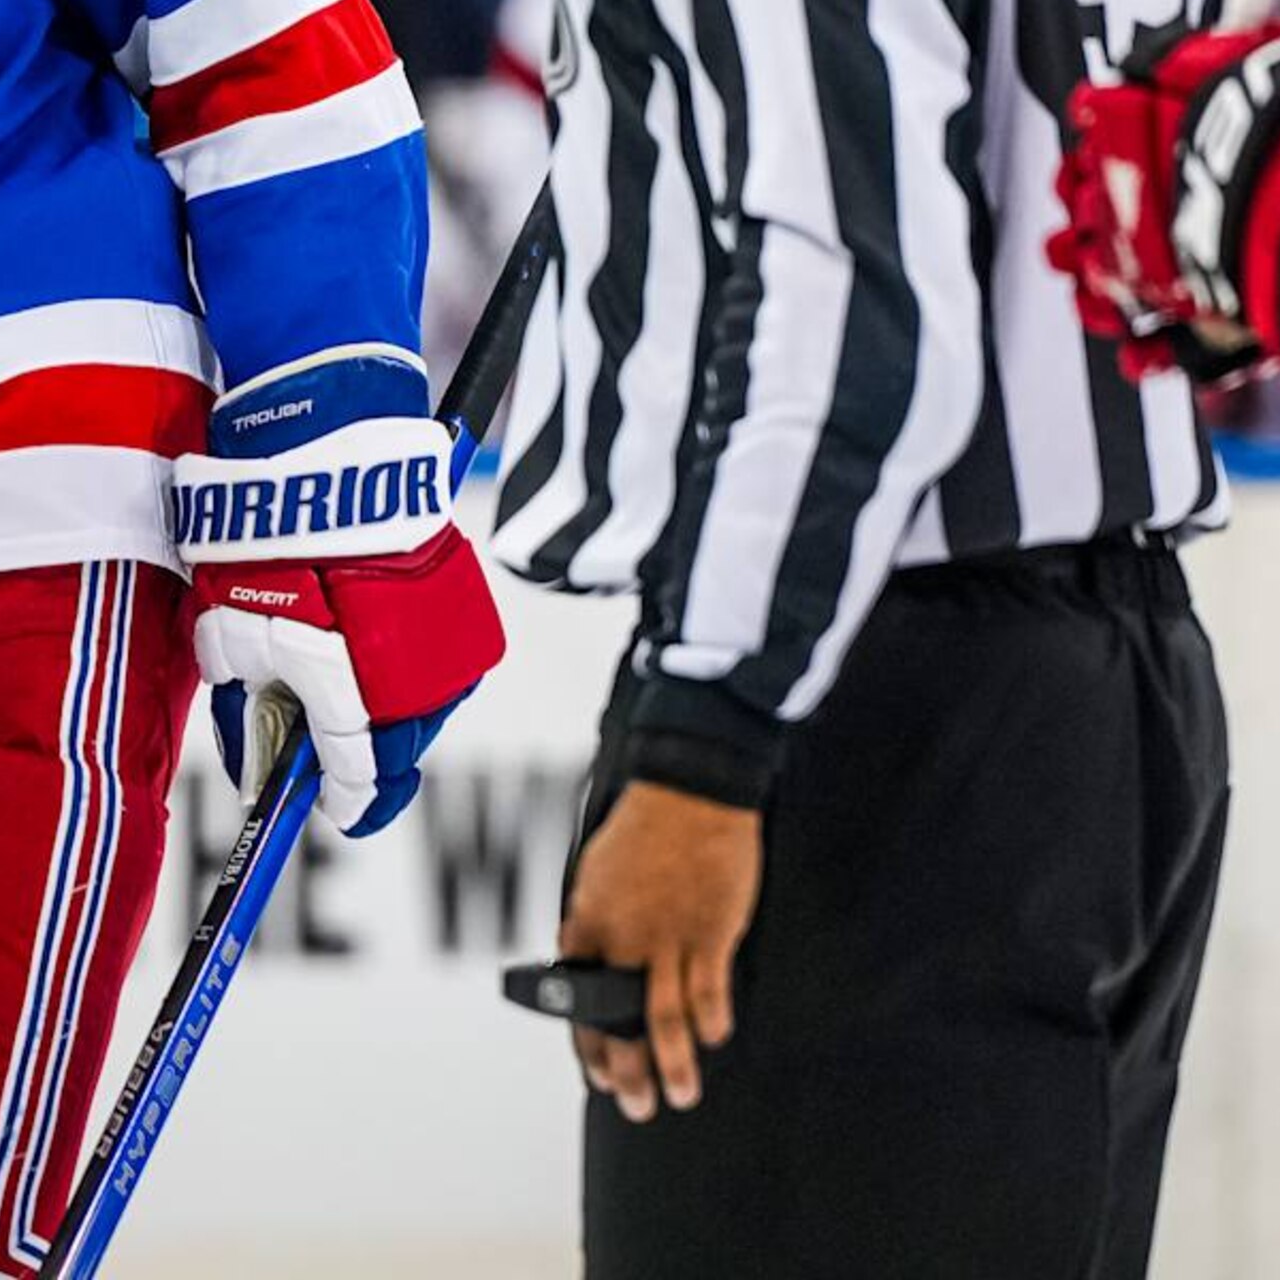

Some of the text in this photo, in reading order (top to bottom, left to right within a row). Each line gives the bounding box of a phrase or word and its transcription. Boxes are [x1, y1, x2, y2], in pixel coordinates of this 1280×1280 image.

[232, 399, 313, 432] TROUBA
[229, 585, 299, 607] COVERT
[219, 818, 263, 886] TROUBA
